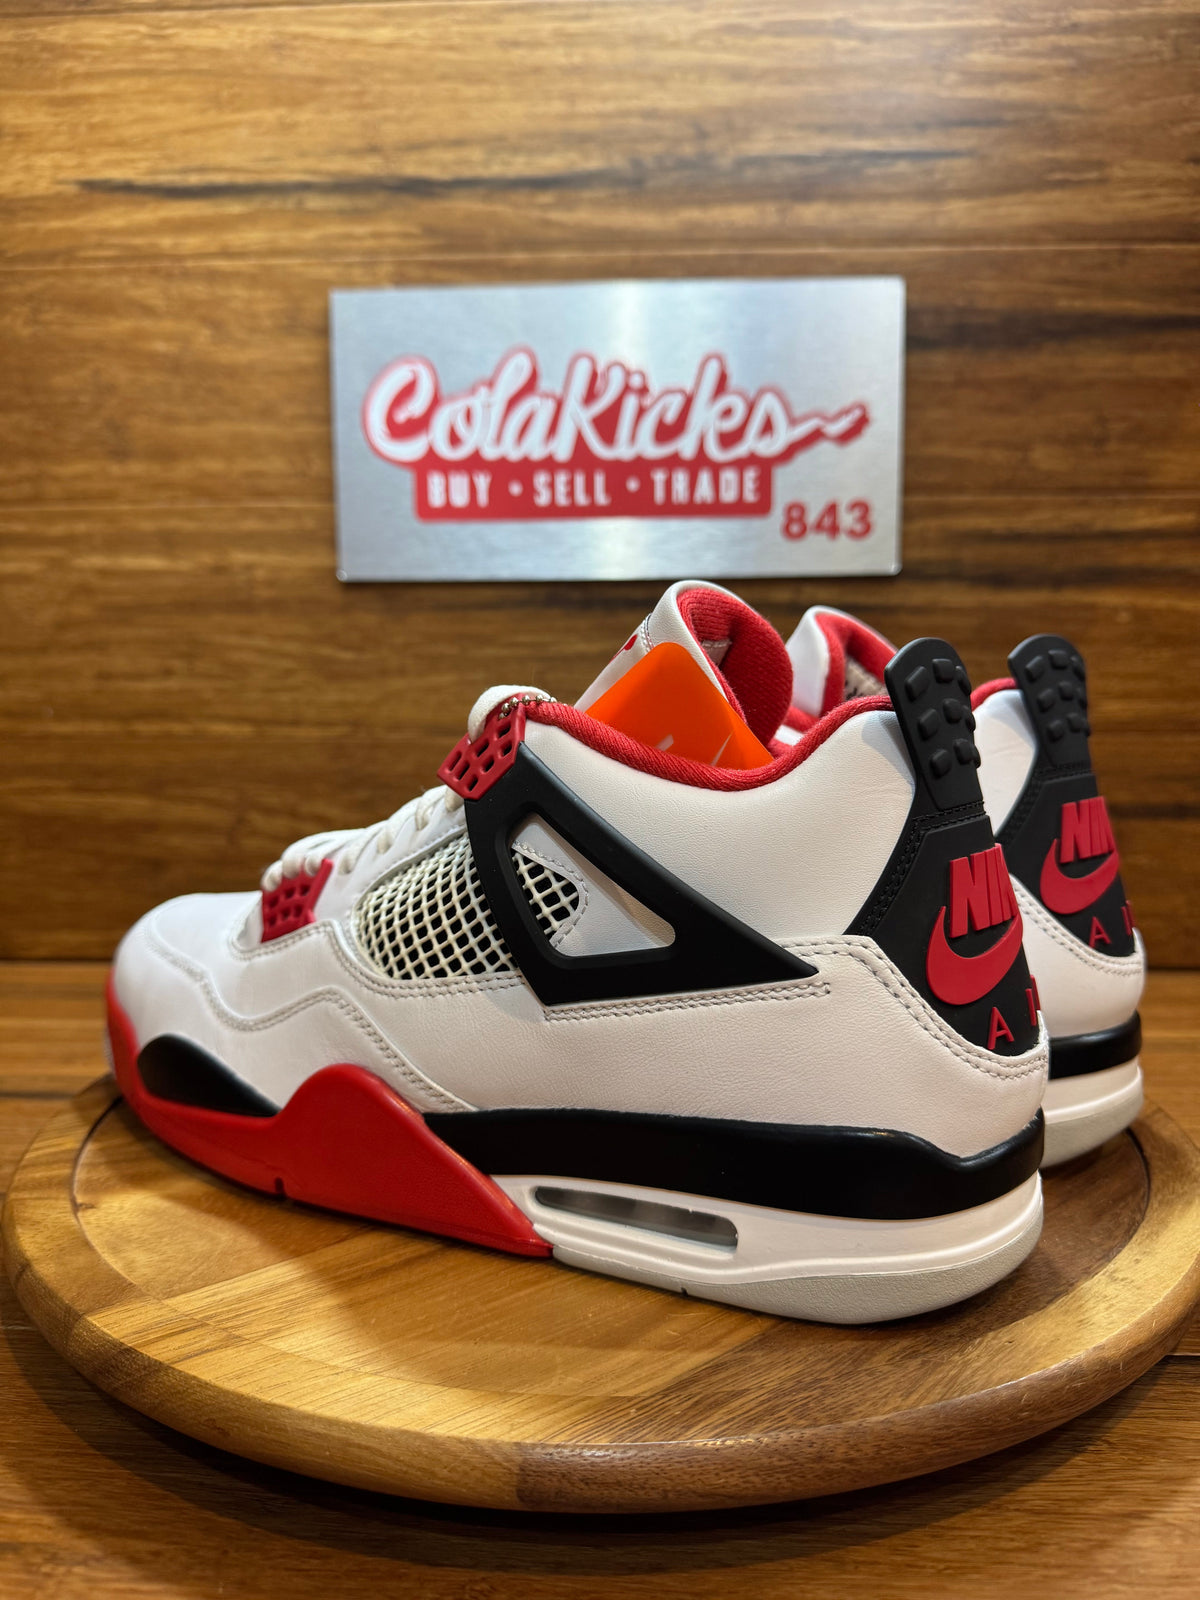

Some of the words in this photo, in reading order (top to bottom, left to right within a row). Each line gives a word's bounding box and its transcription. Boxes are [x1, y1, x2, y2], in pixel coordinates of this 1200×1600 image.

[365, 348, 868, 464] ColaKicks
[426, 470, 492, 509] BUY
[532, 468, 612, 507] SELL
[651, 466, 761, 505] TRADE
[781, 499, 874, 541] 843
[987, 974, 1041, 1050] AI
